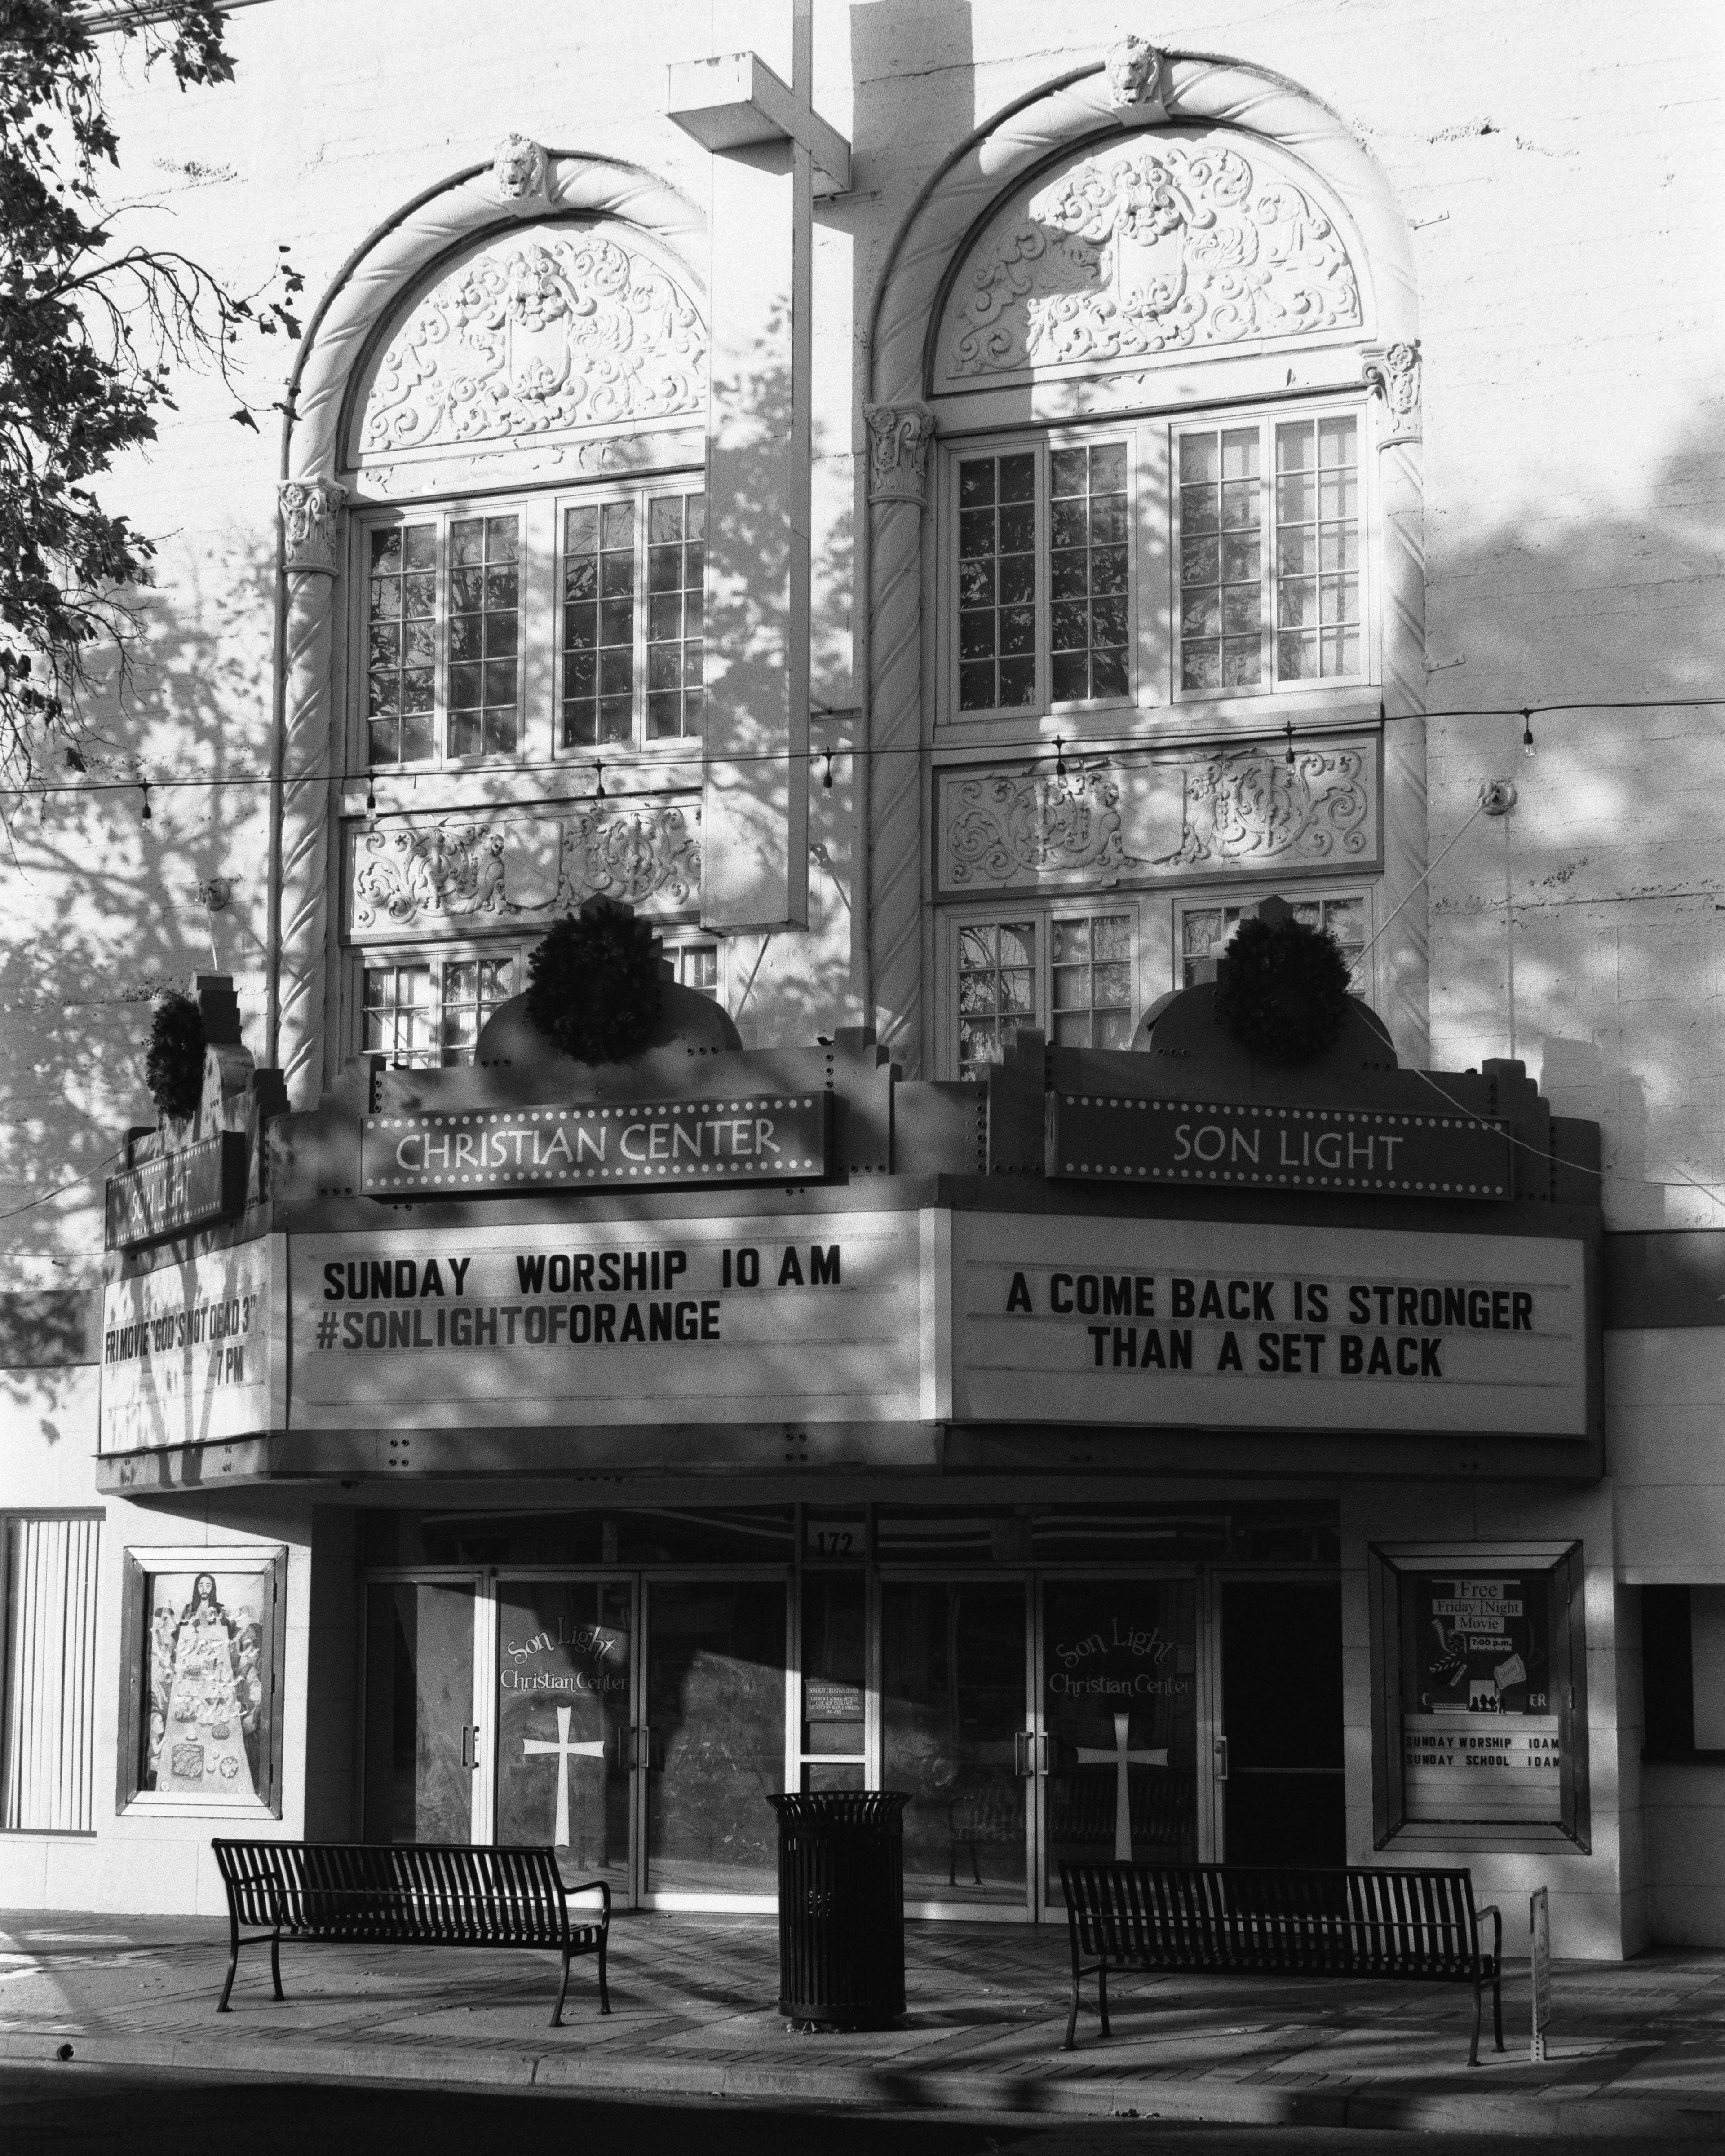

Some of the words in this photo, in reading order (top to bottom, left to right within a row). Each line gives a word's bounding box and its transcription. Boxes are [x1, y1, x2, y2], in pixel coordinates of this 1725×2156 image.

[396, 1127, 606, 1171] CHRISTIAN
[620, 1118, 780, 1161] CENTER
[1174, 1125, 1260, 1163] SON
[1280, 1131, 1403, 1170] LIGHT
[132, 1184, 154, 1223] SON
[158, 1170, 191, 1212] LIGHT
[324, 1258, 471, 1300] SUNDAY
[517, 1251, 687, 1294] WORSHIP
[722, 1248, 760, 1288] 10
[1006, 1272, 1033, 1312] A
[1050, 1273, 1154, 1317] COME
[1172, 1278, 1275, 1321] BACK
[1293, 1281, 1328, 1323] IS
[1349, 1285, 1532, 1330] STRONGER
[106, 1329, 119, 1364] FRI
[120, 1322, 149, 1361] MOVIE
[187, 1306, 208, 1345] NOT
[209, 1299, 239, 1340] DEAD
[316, 1300, 720, 1349] #SONLIGHTOFORANGE
[217, 1349, 224, 1386] 7
[226, 1345, 243, 1384] PM
[1088, 1326, 1193, 1370] THAN
[1217, 1331, 1243, 1371] A
[1259, 1333, 1325, 1373] SET
[1340, 1335, 1442, 1377] BACK
[817, 1532, 853, 1557] 172
[1438, 1600, 1476, 1615] Friday
[1485, 1601, 1519, 1615] Night
[1461, 1581, 1498, 1597] Free
[508, 1631, 555, 1664] Son
[557, 1617, 617, 1662] Light
[1056, 1633, 1109, 1668] Son
[1111, 1617, 1177, 1665] Light
[1460, 1617, 1499, 1629] Movie
[1492, 1639, 1512, 1648] p.m.
[500, 1669, 576, 1693] Christian
[576, 1671, 629, 1692] Center
[1049, 1673, 1134, 1697] Christian
[1135, 1674, 1192, 1697] Center
[1406, 1736, 1454, 1748] SUNDAY
[1459, 1737, 1511, 1748] WORSHIP
[1406, 1754, 1453, 1765] SUNDAY
[1465, 1755, 1509, 1766] SCHOOL
